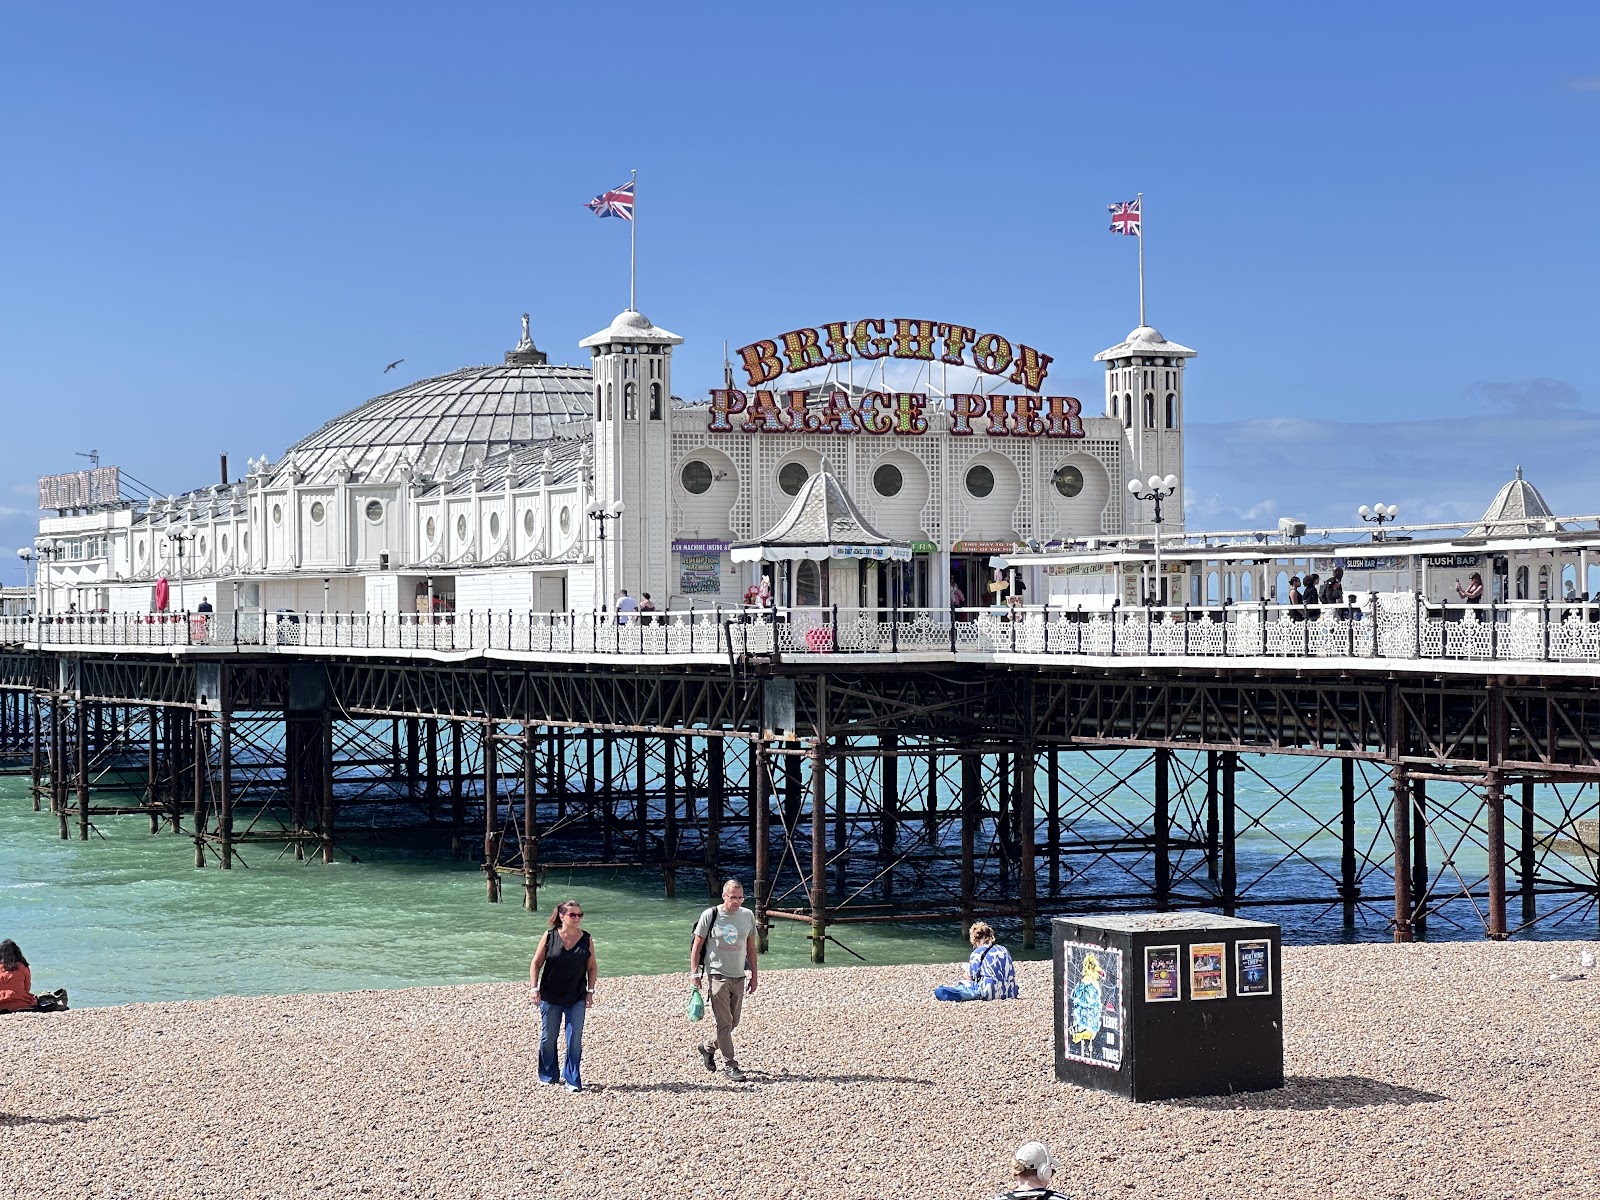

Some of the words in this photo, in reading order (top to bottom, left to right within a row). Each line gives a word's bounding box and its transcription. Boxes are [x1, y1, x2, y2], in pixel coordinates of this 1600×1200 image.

[735, 318, 1054, 393] BRIGHTON
[708, 389, 927, 435] PALACE
[950, 393, 1086, 438] PIER
[1346, 559, 1364, 568] SLUSH
[1364, 559, 1376, 568] BAR
[1456, 556, 1476, 565] BAR
[1103, 1015, 1118, 1029] LEAVE
[1106, 1031, 1115, 1046] NO
[1102, 1046, 1119, 1062] TRACE
